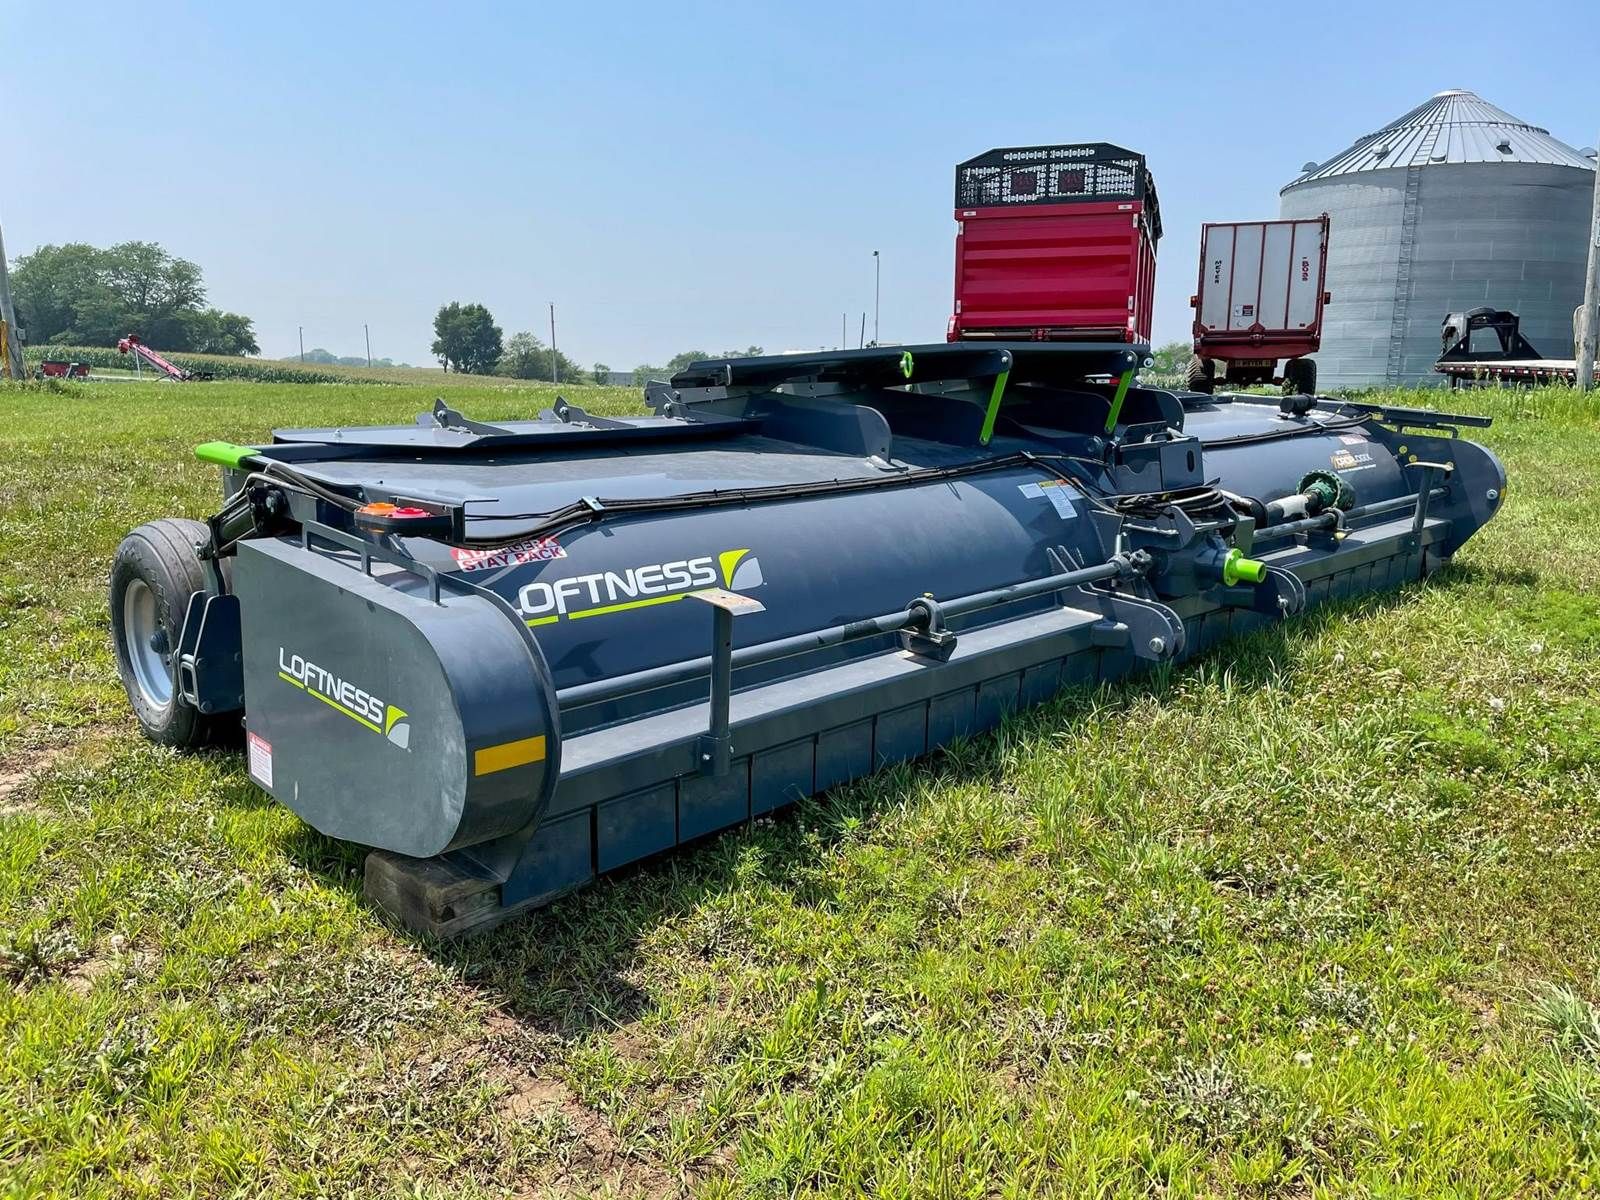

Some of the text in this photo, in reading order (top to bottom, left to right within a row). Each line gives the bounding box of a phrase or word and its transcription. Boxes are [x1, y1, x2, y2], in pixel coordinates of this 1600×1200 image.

[1214, 259, 1222, 284] MEYER
[463, 546, 562, 571] STAY BACK
[515, 556, 718, 615] OFTNESS
[279, 646, 385, 724] LOFTNESS
